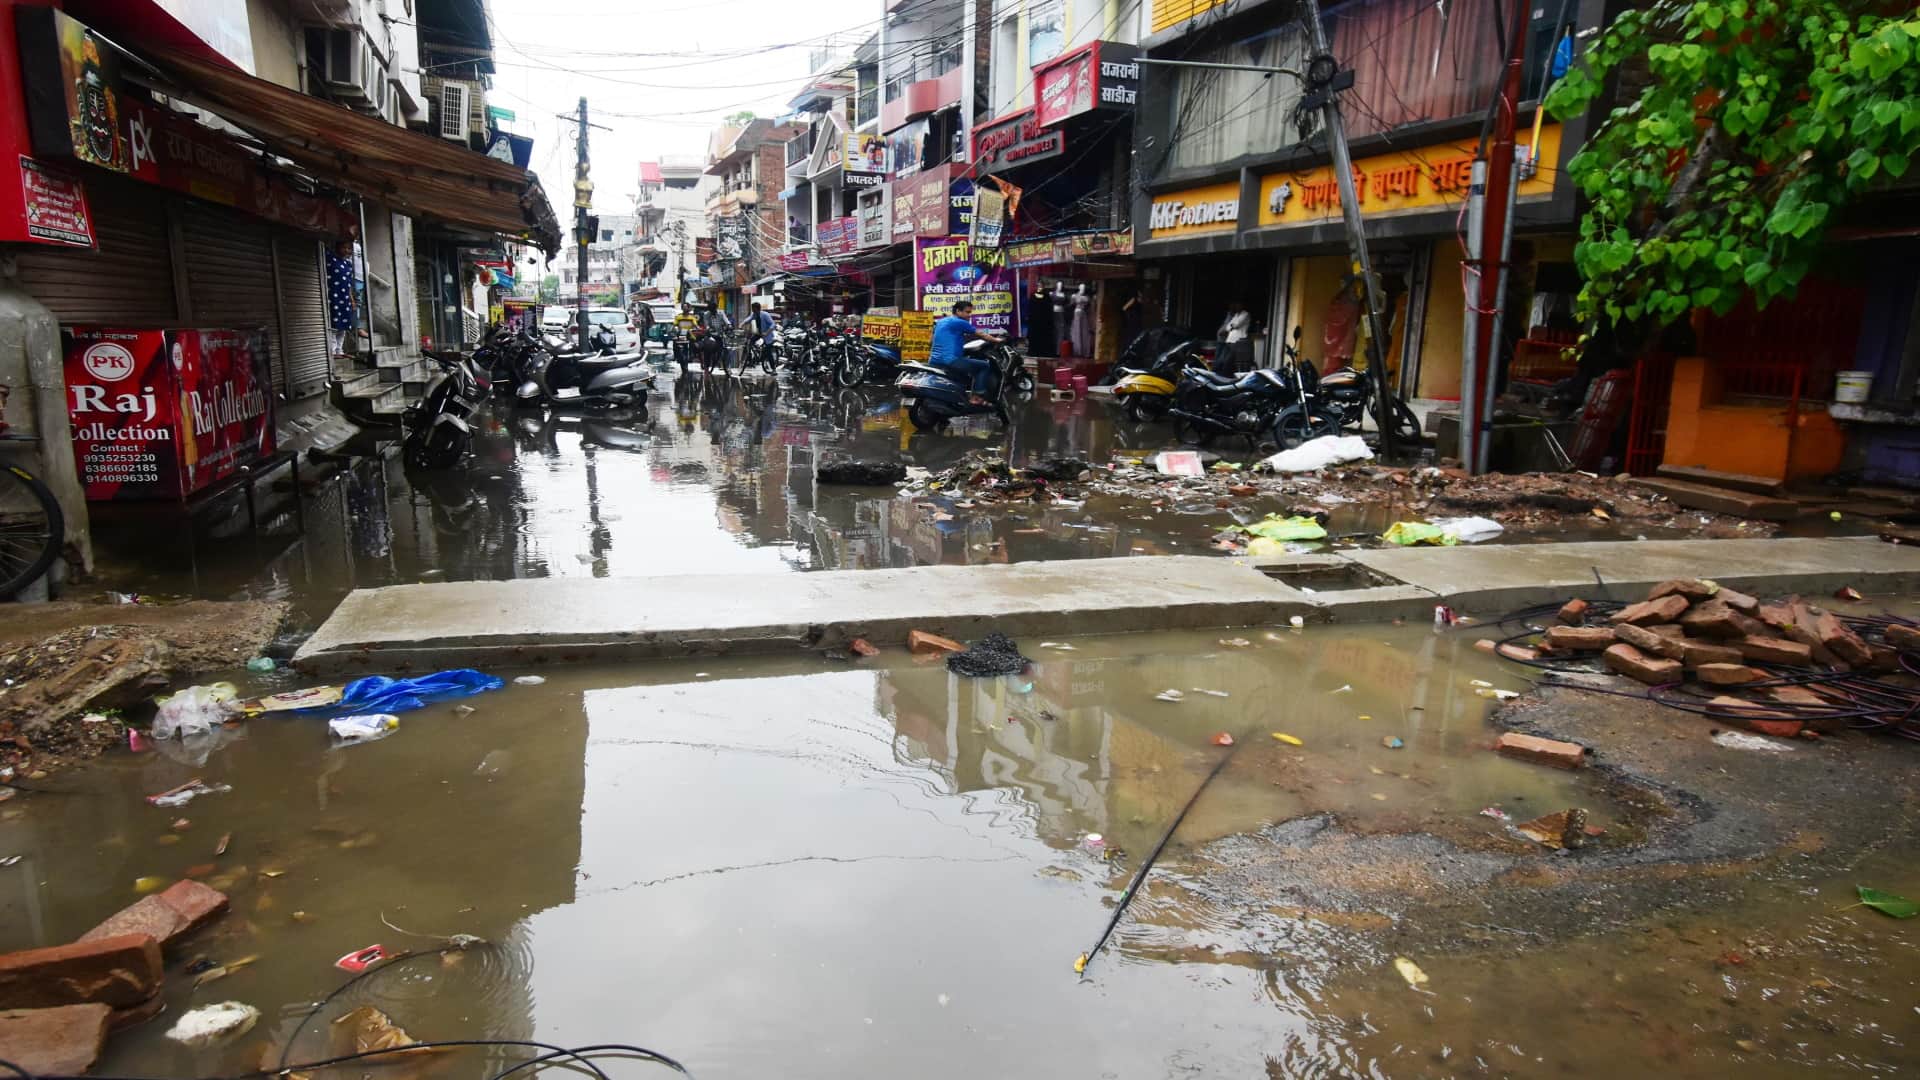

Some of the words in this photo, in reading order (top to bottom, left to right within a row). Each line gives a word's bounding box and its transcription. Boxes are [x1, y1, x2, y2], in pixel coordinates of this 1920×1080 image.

[1101, 61, 1139, 79] राजरानी
[922, 240, 968, 272] राजरानी
[91, 355, 128, 369] PK
[69, 384, 157, 422] Raj
[189, 390, 216, 446] Raj
[213, 379, 266, 430] Collection
[90, 443, 139, 453] Contact
